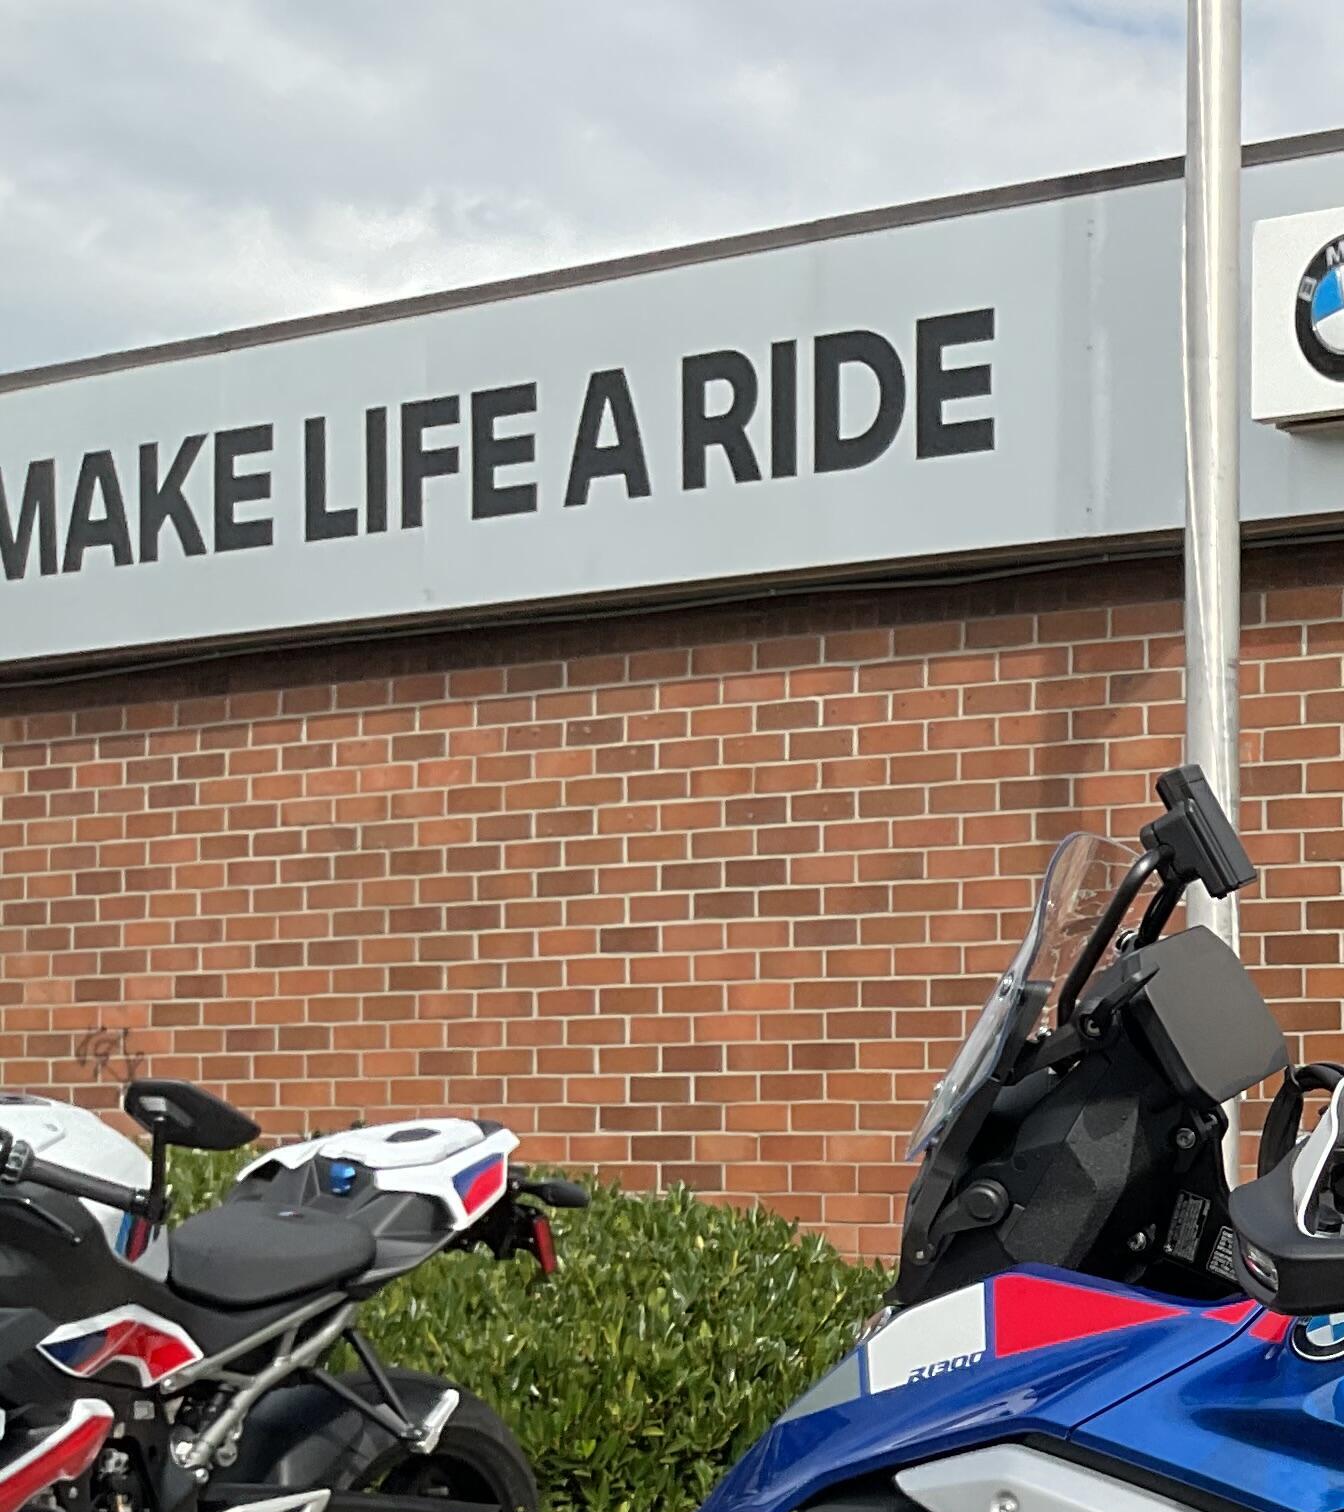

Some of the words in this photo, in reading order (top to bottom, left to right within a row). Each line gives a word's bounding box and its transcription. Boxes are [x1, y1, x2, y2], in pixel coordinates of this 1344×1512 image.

[0, 422, 274, 582] MAKE
[304, 381, 539, 544] LIFE
[563, 367, 652, 509] A
[681, 306, 997, 493] RIDE
